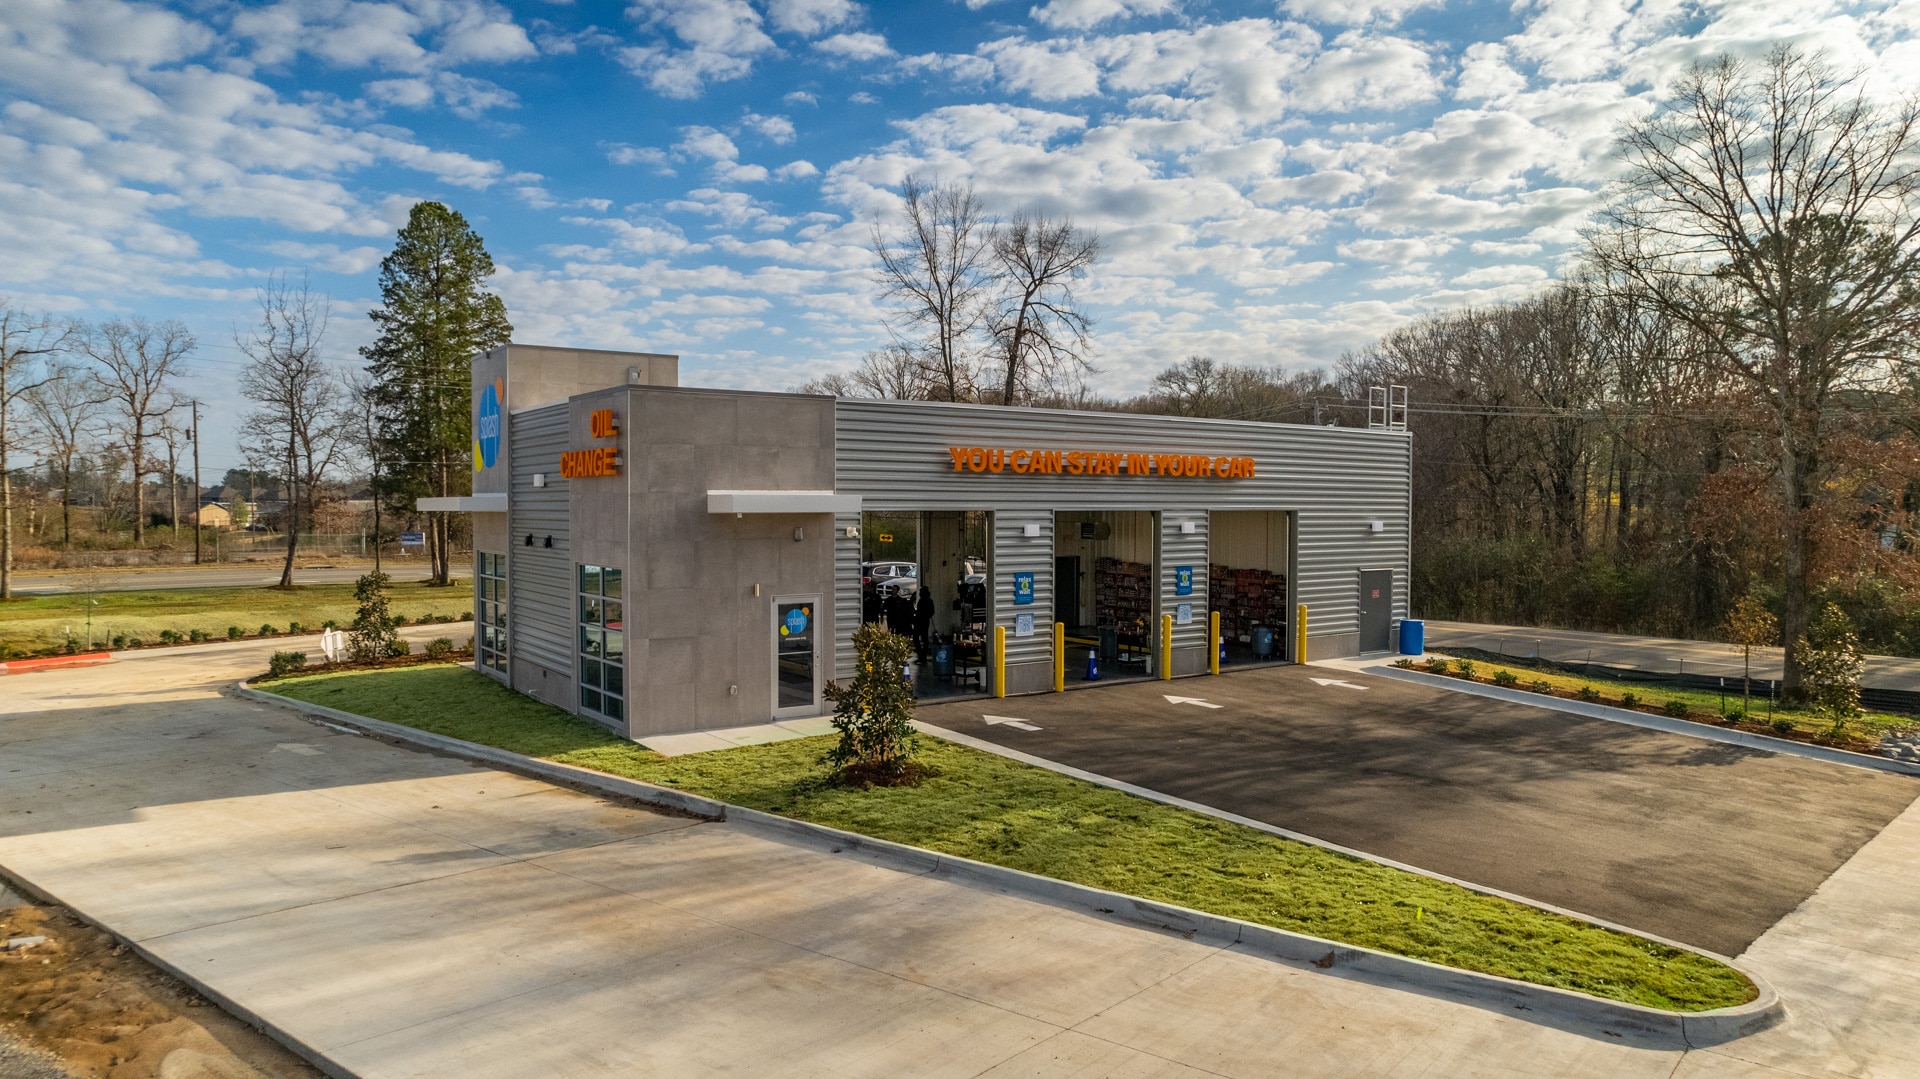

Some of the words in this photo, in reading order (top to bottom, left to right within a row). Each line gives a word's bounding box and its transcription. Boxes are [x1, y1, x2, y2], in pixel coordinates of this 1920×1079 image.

[590, 408, 617, 438] OIL
[560, 448, 617, 478] CHANGE
[949, 447, 1005, 473] YOU
[1009, 449, 1062, 474] CAN
[1066, 451, 1123, 475] STAY
[1127, 453, 1150, 475] IN
[1153, 453, 1211, 477] YOUR
[1214, 456, 1255, 478] CAR
